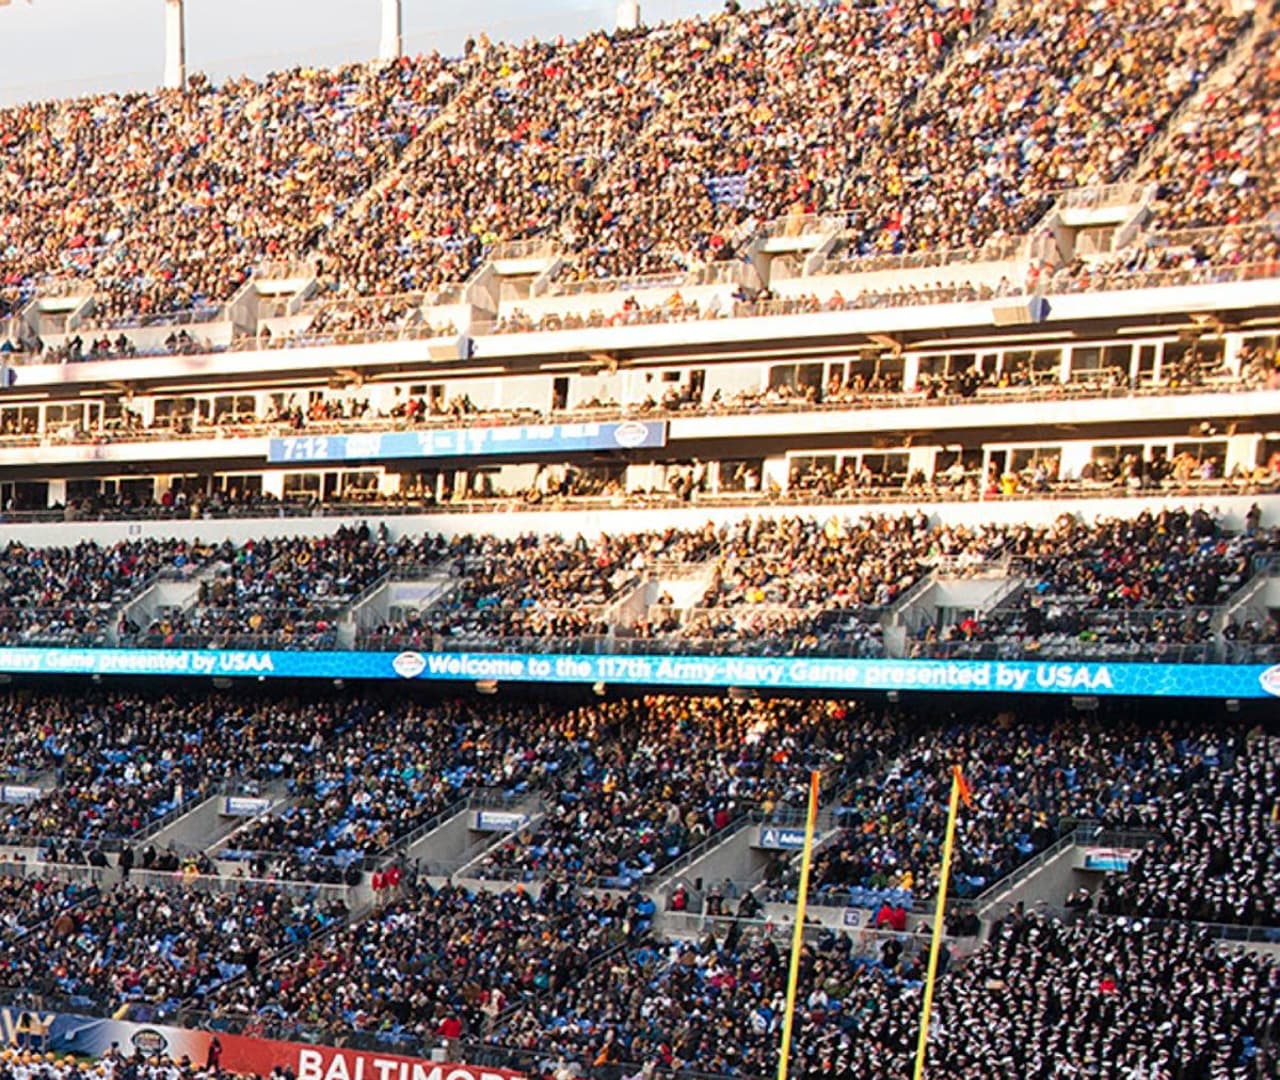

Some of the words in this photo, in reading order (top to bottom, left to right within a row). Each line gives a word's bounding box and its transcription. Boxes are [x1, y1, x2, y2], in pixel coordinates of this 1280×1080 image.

[282, 437, 329, 459] 7:12
[46, 652, 96, 668] Game
[99, 652, 188, 672] presented
[192, 653, 216, 673] by
[220, 654, 274, 671] USAA
[428, 655, 524, 676] Welcome
[528, 657, 551, 677] to
[556, 656, 591, 678] the
[596, 658, 651, 678] 117th
[656, 659, 784, 682] Army-Navy
[790, 661, 858, 681] Game
[865, 663, 991, 687] presented
[996, 665, 1029, 690] by
[1036, 666, 1113, 689] USAA
